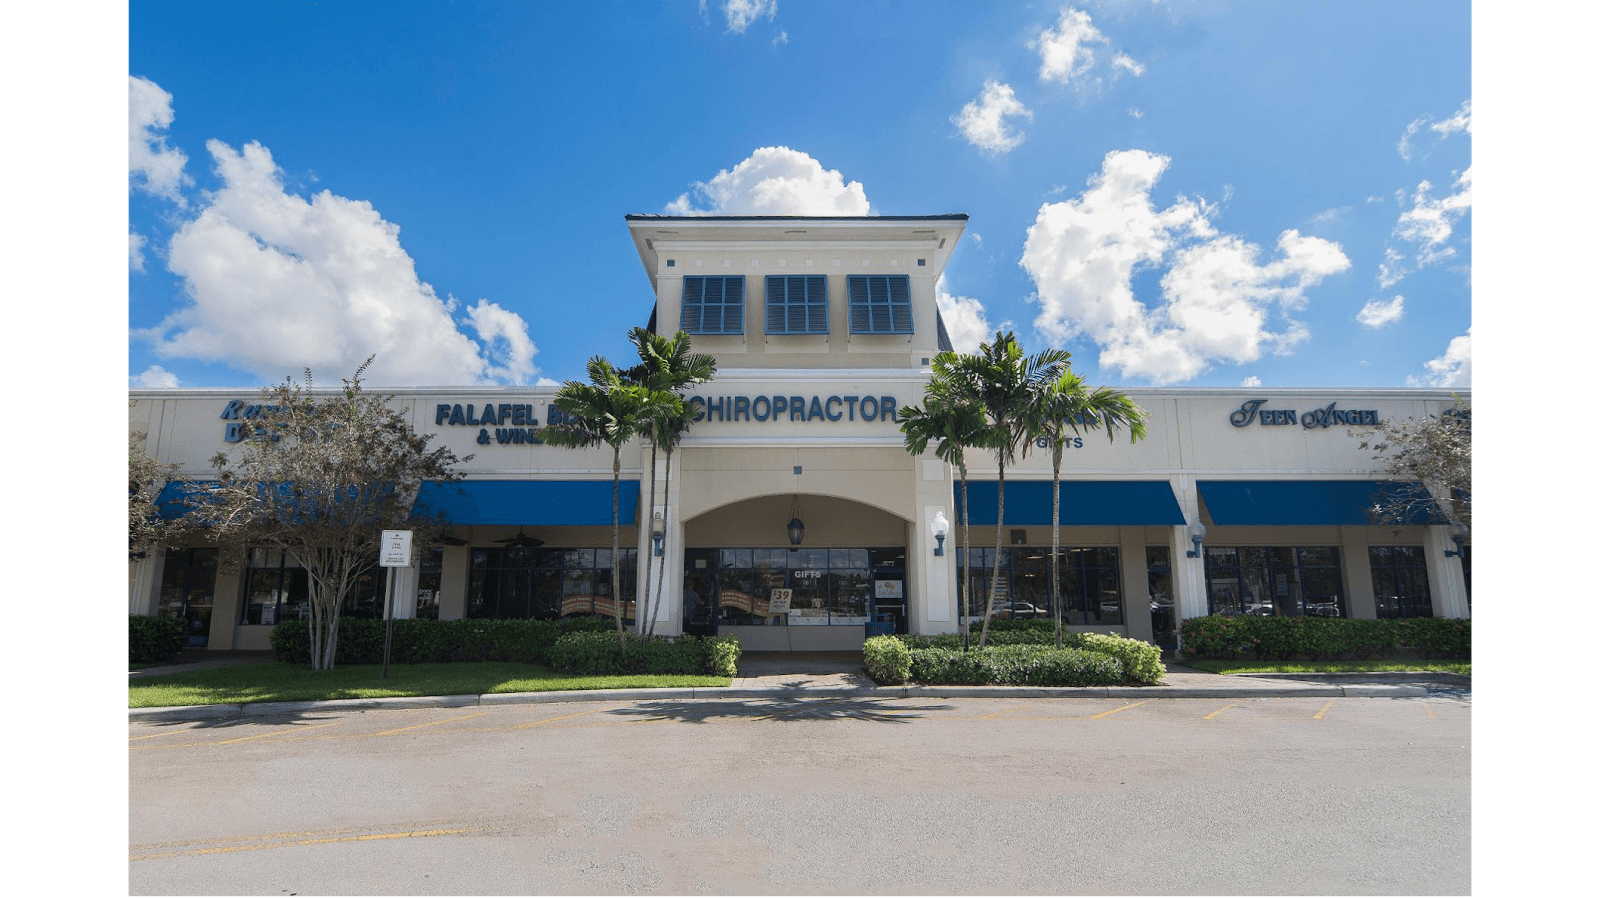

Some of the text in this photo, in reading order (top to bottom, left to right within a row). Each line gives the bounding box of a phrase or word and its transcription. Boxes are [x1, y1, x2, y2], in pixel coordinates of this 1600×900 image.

[436, 404, 538, 426] FALAFEL
[690, 395, 897, 422] CHIROPRACTOR
[476, 429, 491, 445] &
[1036, 437, 1083, 449] GITS
[794, 570, 822, 579] GIFTS
